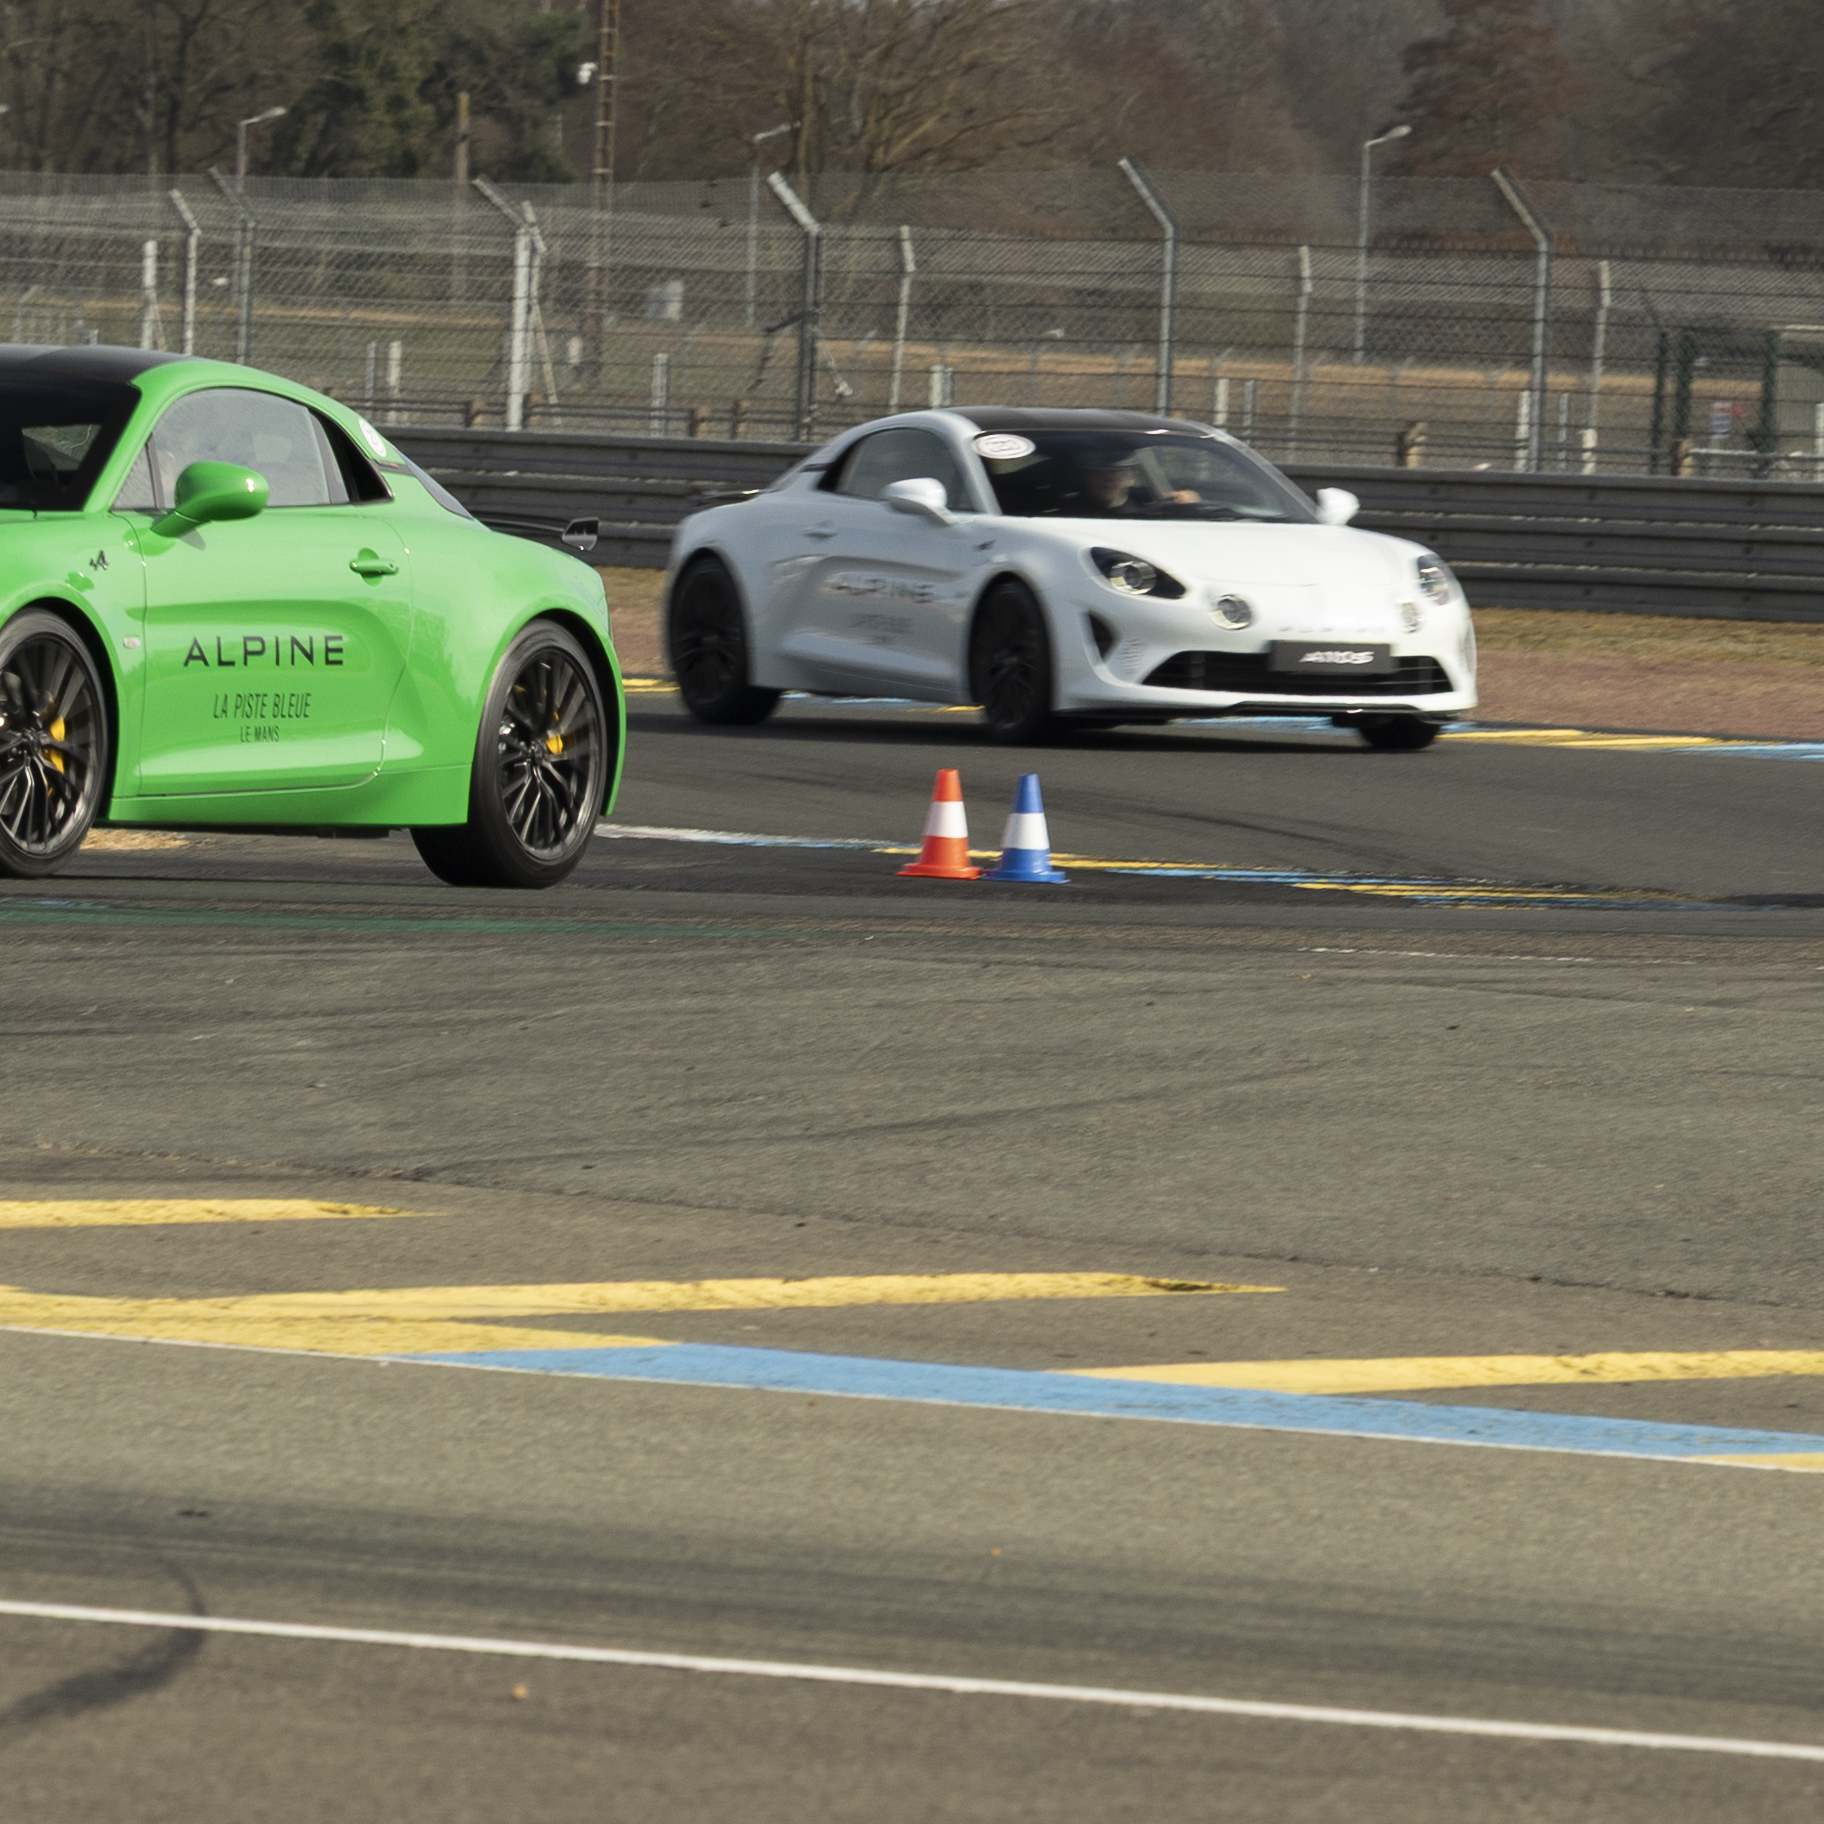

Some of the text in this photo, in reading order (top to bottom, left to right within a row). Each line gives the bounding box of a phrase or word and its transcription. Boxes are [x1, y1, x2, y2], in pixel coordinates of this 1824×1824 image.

[183, 635, 344, 667] ALPINE
[213, 692, 312, 719] LA PISTE BLEUE
[239, 725, 281, 743] LE MANS
